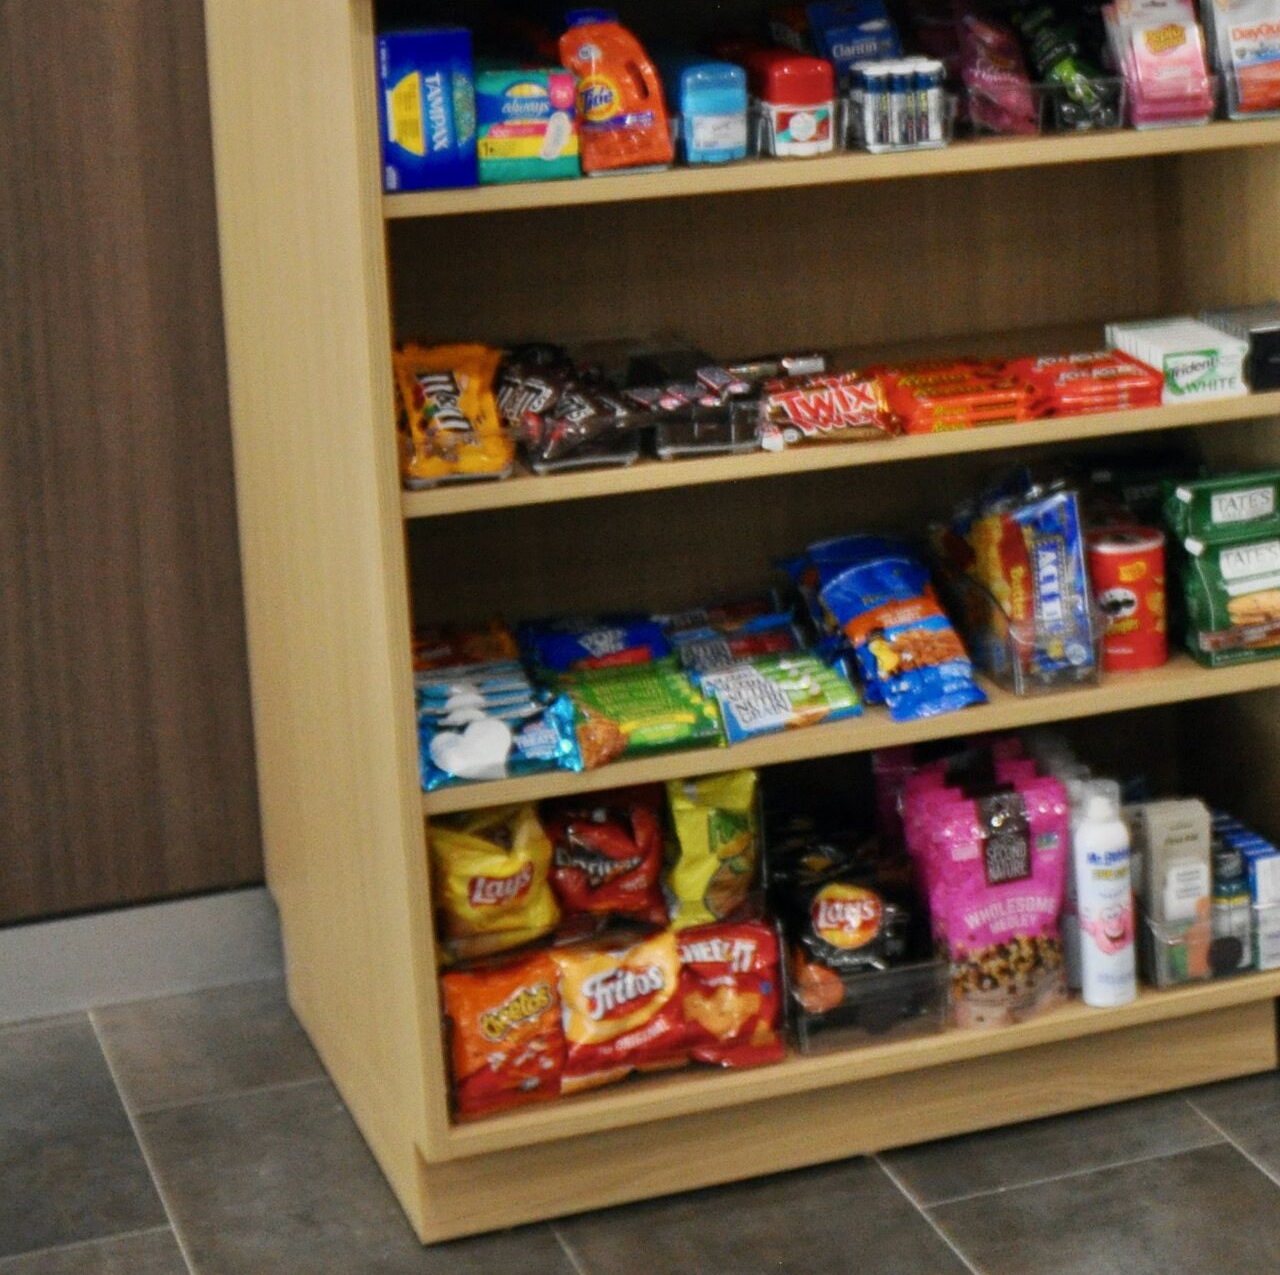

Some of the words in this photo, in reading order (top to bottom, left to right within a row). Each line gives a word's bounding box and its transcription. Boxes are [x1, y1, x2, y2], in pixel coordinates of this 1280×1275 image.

[424, 71, 450, 153] TAMPAX
[501, 99, 550, 117] always
[581, 84, 614, 113] Tide
[1185, 376, 1237, 394] WHITE
[963, 896, 1056, 930] WHOLESOME
[581, 965, 664, 1021] Fritos
